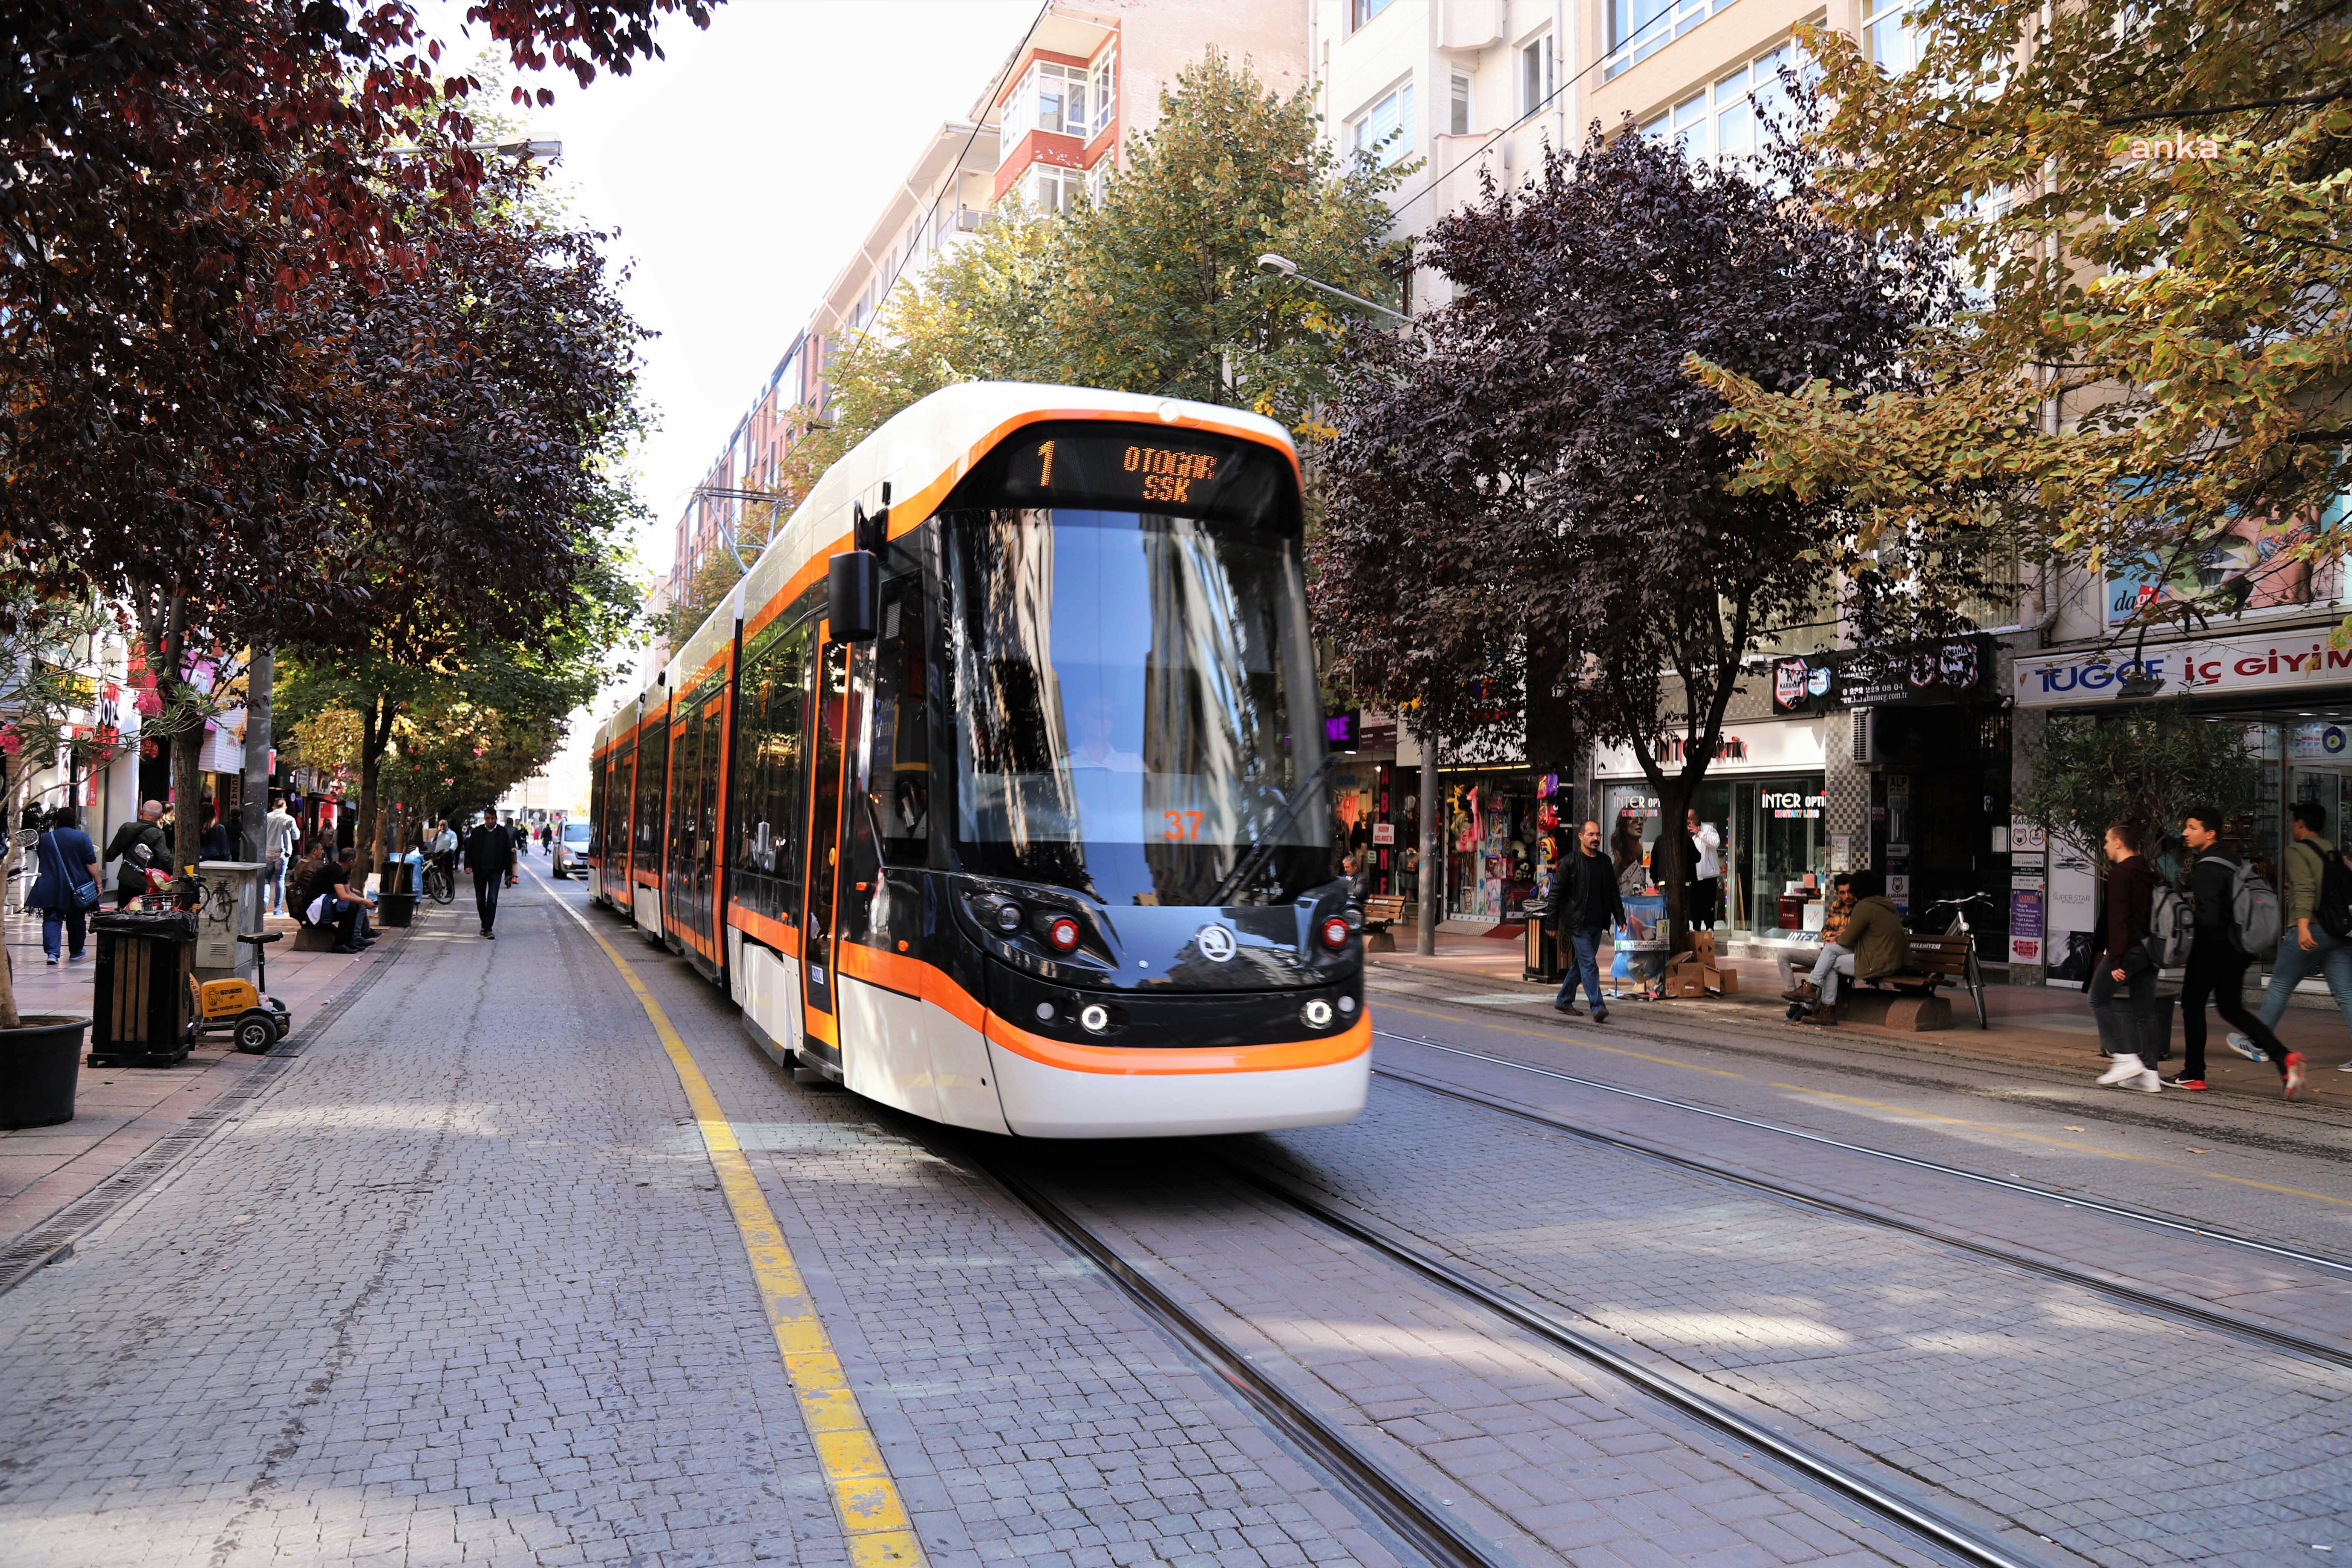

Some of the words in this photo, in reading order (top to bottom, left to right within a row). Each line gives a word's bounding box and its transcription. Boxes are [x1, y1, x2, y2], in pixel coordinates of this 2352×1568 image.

[1038, 439, 1055, 487] 1
[1124, 446, 1217, 479] OTOGAR
[1142, 475, 1190, 503] SSK
[2185, 657, 2221, 685] İÇ
[1890, 776, 1907, 787] ALP
[1762, 789, 1801, 808] İNTER
[1805, 790, 1825, 807] OPTİ
[1163, 810, 1205, 841] 37
[1775, 809, 1802, 818] KONTAKT
[1803, 809, 1820, 818] LENS
